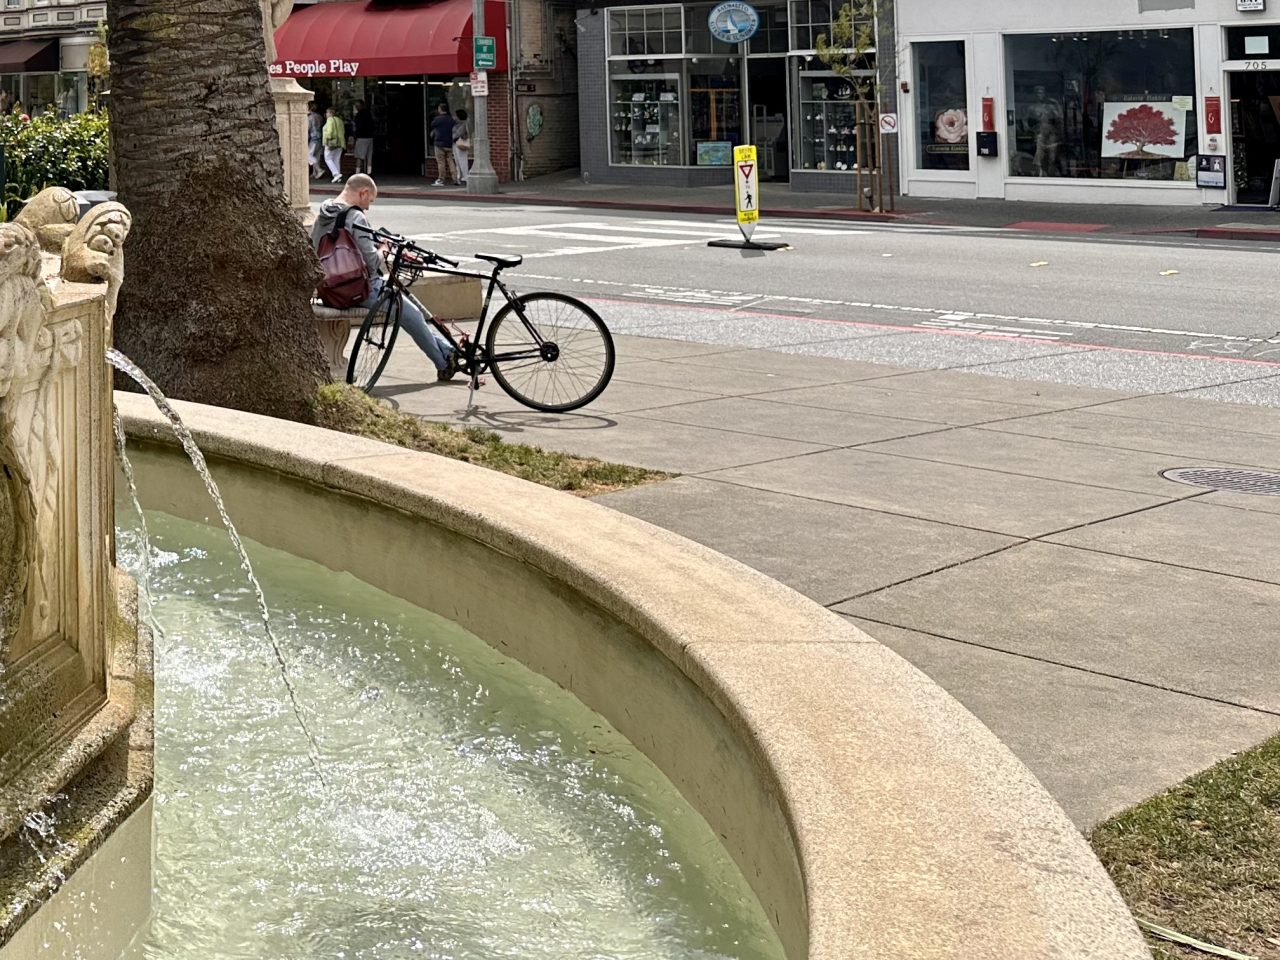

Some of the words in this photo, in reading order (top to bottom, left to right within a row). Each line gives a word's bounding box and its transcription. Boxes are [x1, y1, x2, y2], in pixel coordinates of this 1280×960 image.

[285, 60, 326, 77] People
[329, 59, 359, 76] Play
[1245, 61, 1267, 70] 705
